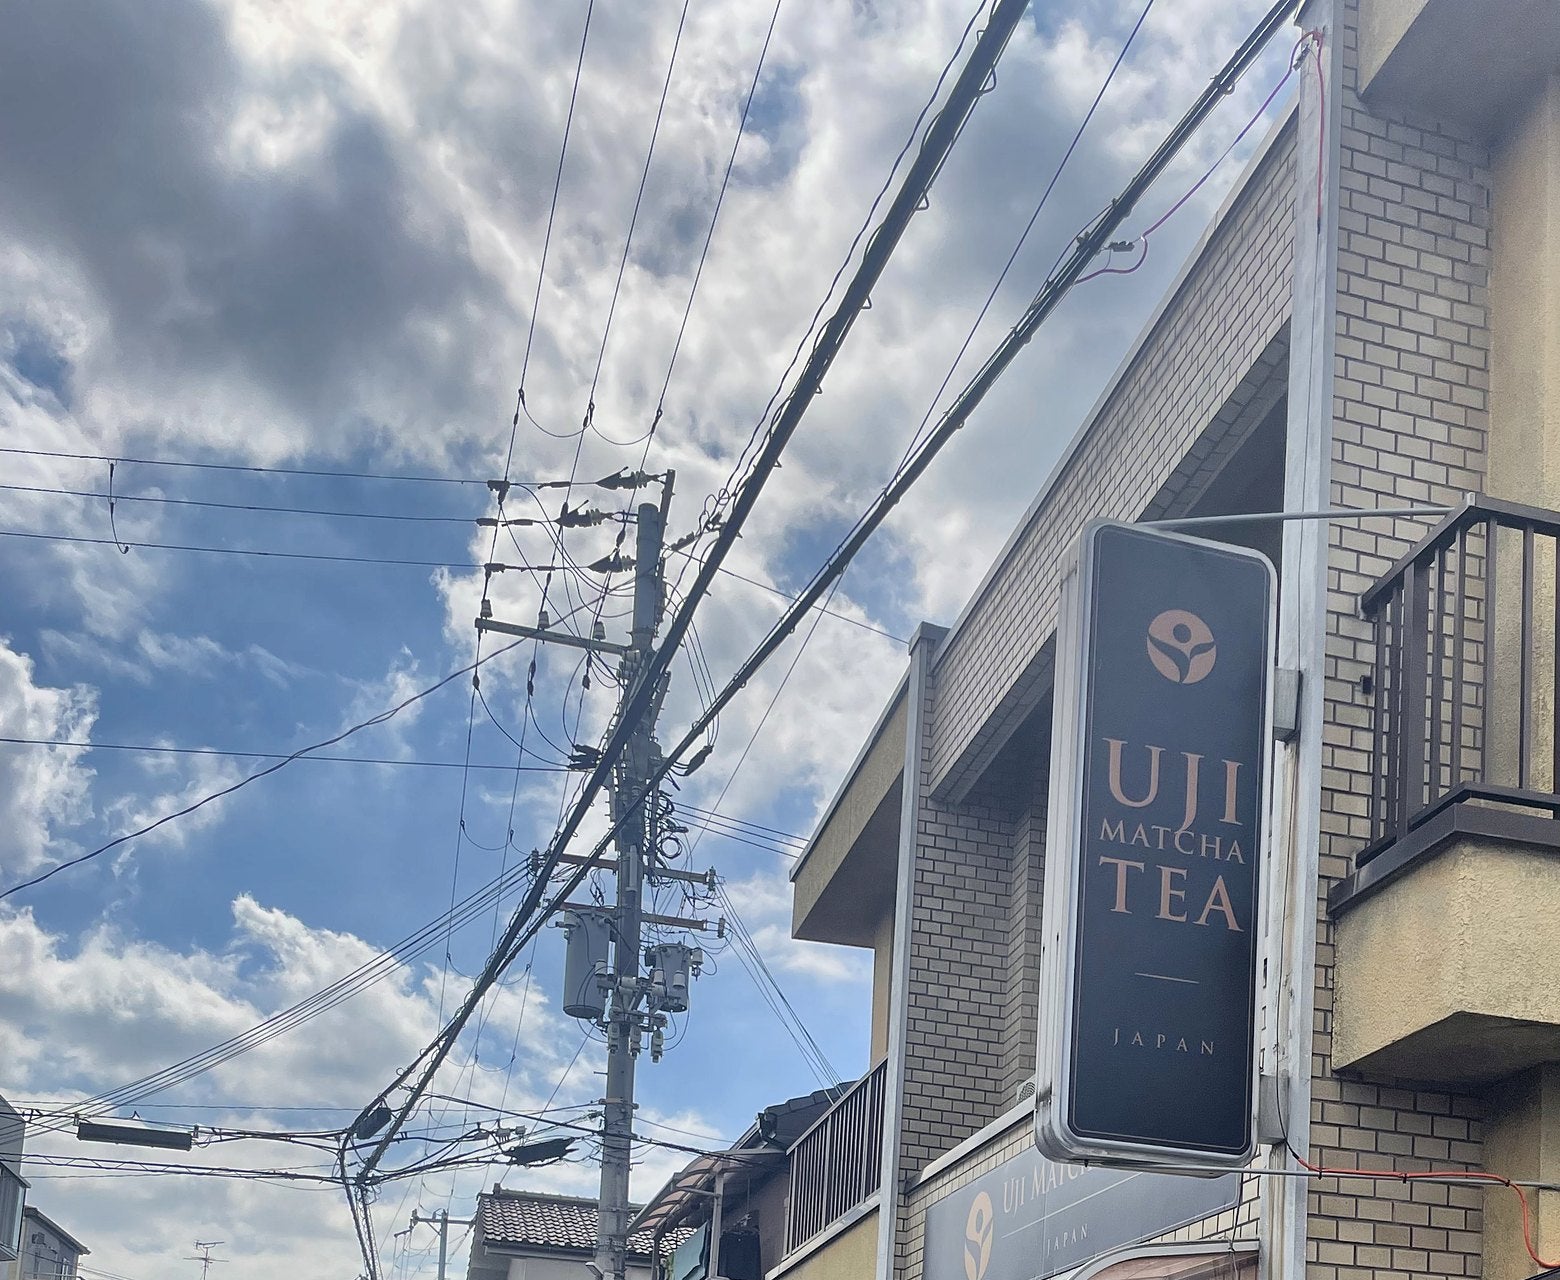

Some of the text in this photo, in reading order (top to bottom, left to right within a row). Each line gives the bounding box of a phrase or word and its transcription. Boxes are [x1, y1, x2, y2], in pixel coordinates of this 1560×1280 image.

[1102, 737, 1244, 831] UJI
[1100, 817, 1246, 865] MATCHA
[1099, 855, 1245, 932] TEA
[1114, 1028, 1214, 1055] JAPAN
[1003, 1162, 1093, 1217] UJI MATC
[1046, 1223, 1088, 1258] JAPAN
